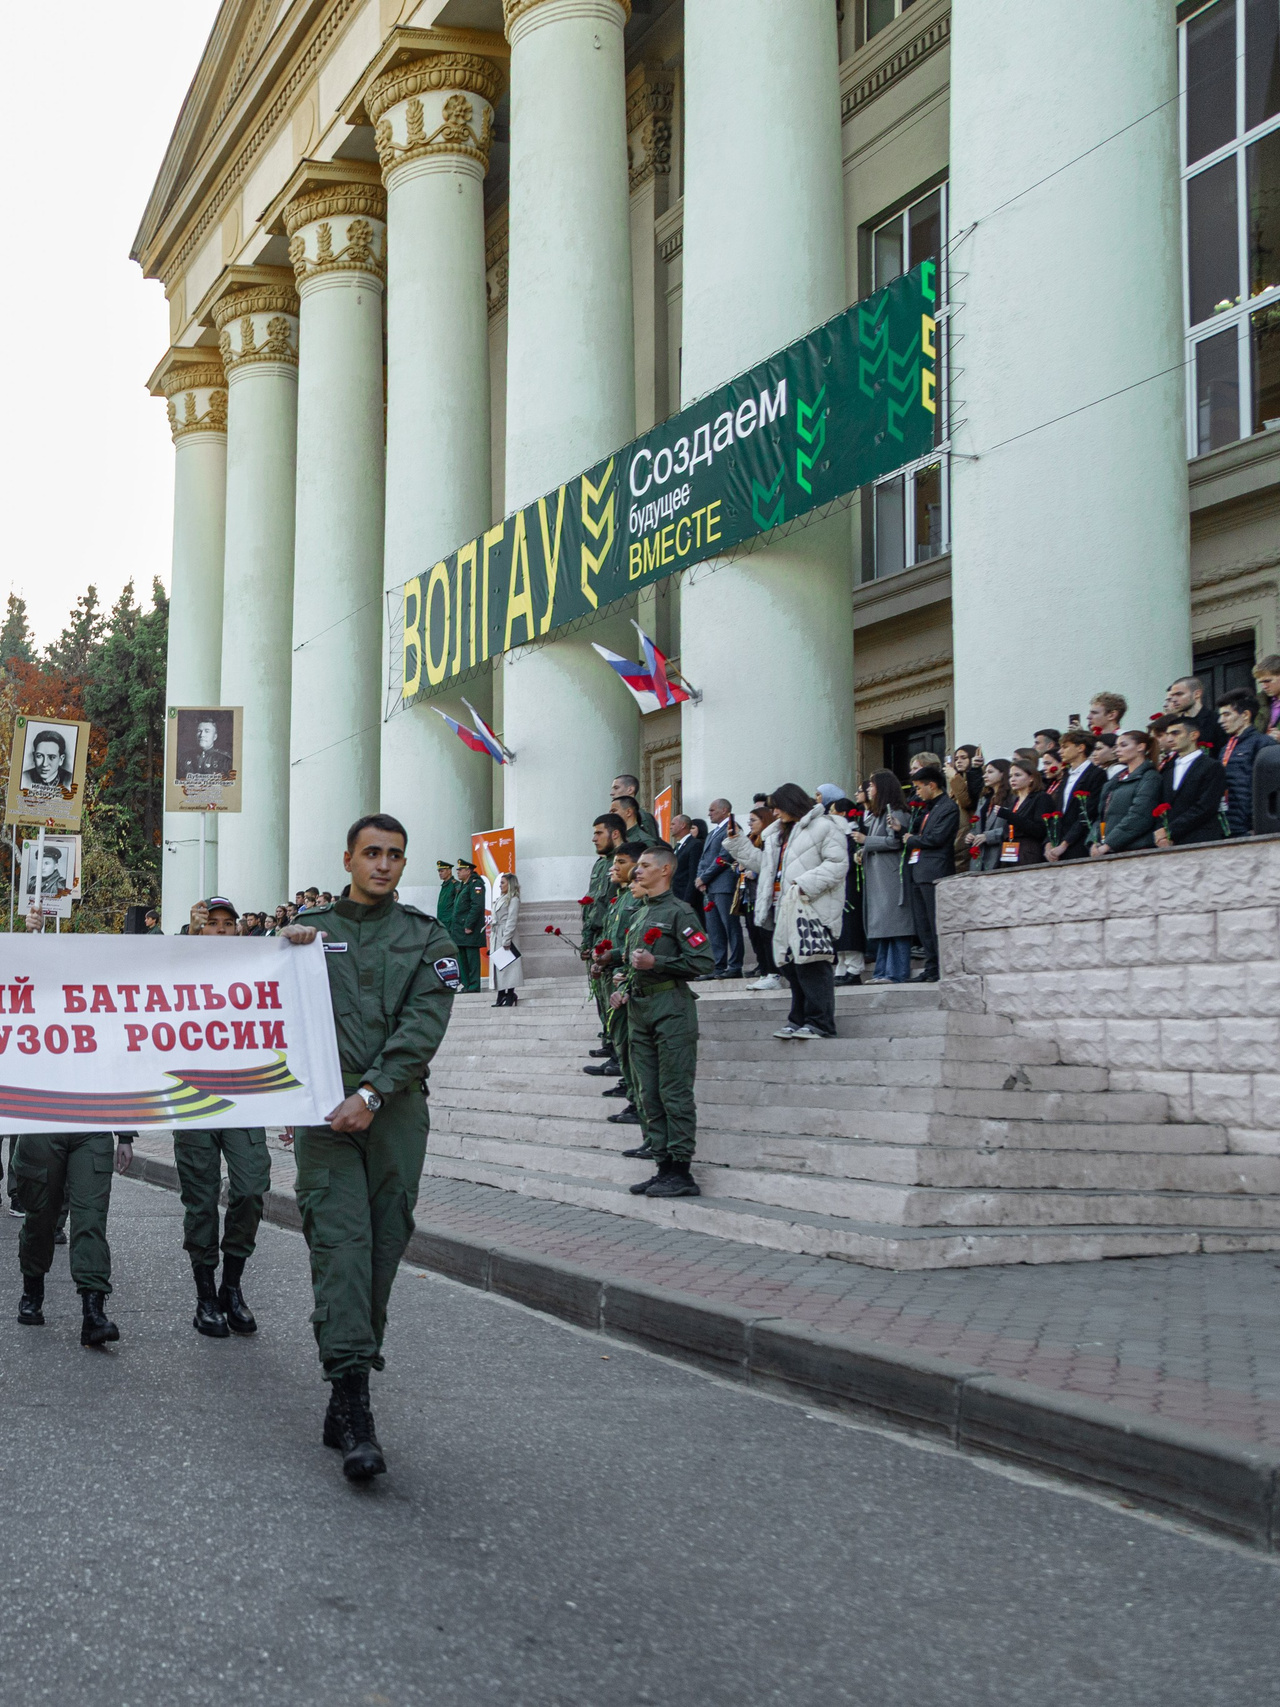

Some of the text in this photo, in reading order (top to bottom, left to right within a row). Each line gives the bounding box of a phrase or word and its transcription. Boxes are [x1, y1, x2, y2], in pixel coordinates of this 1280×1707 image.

[629, 378, 787, 497] Создаем
[629, 483, 690, 535] будущее
[629, 499, 722, 582] ВМЕСТЕ
[402, 484, 566, 699] ВОЛГАУ
[63, 980, 283, 1012] БАТАЛЬОН
[124, 1020, 288, 1052] РОССИИ
